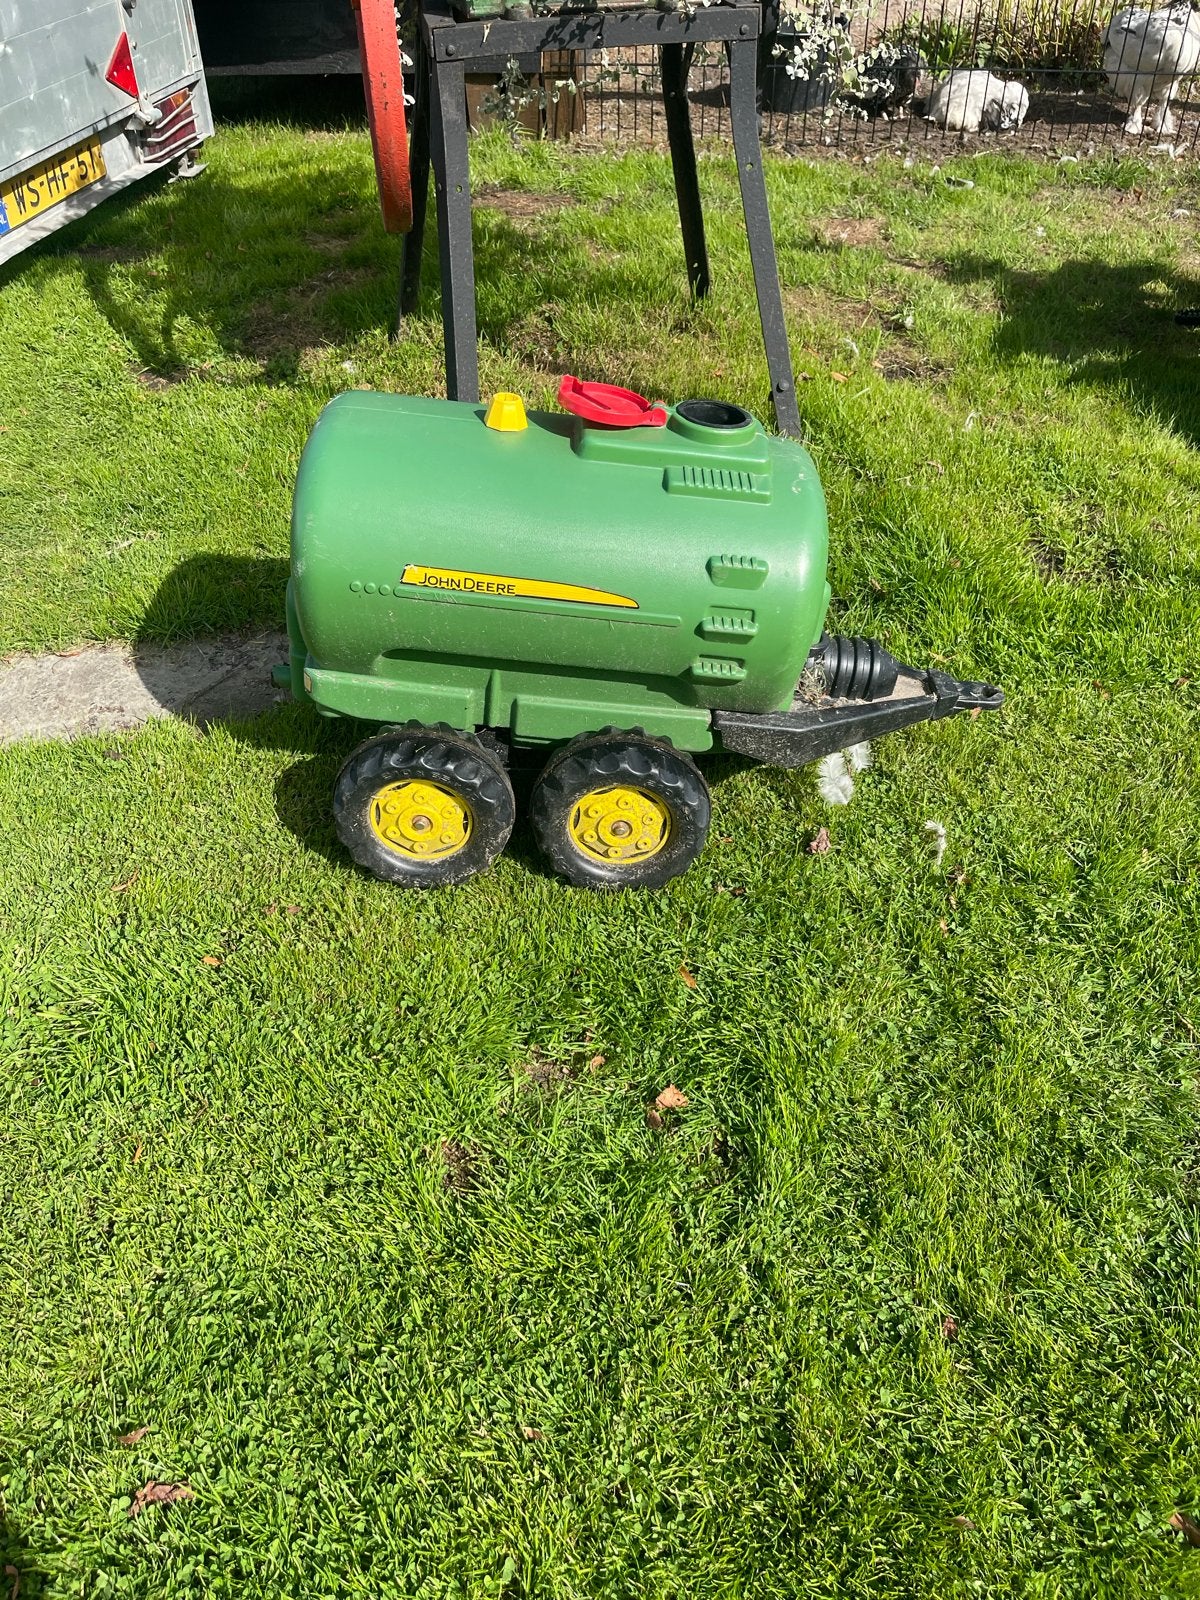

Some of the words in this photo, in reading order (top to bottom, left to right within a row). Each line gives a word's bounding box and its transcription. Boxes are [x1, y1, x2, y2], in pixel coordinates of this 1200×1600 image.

[11, 144, 96, 216] WS-HF-51
[419, 573, 461, 588] JOHN
[463, 578, 516, 594] DEERE
